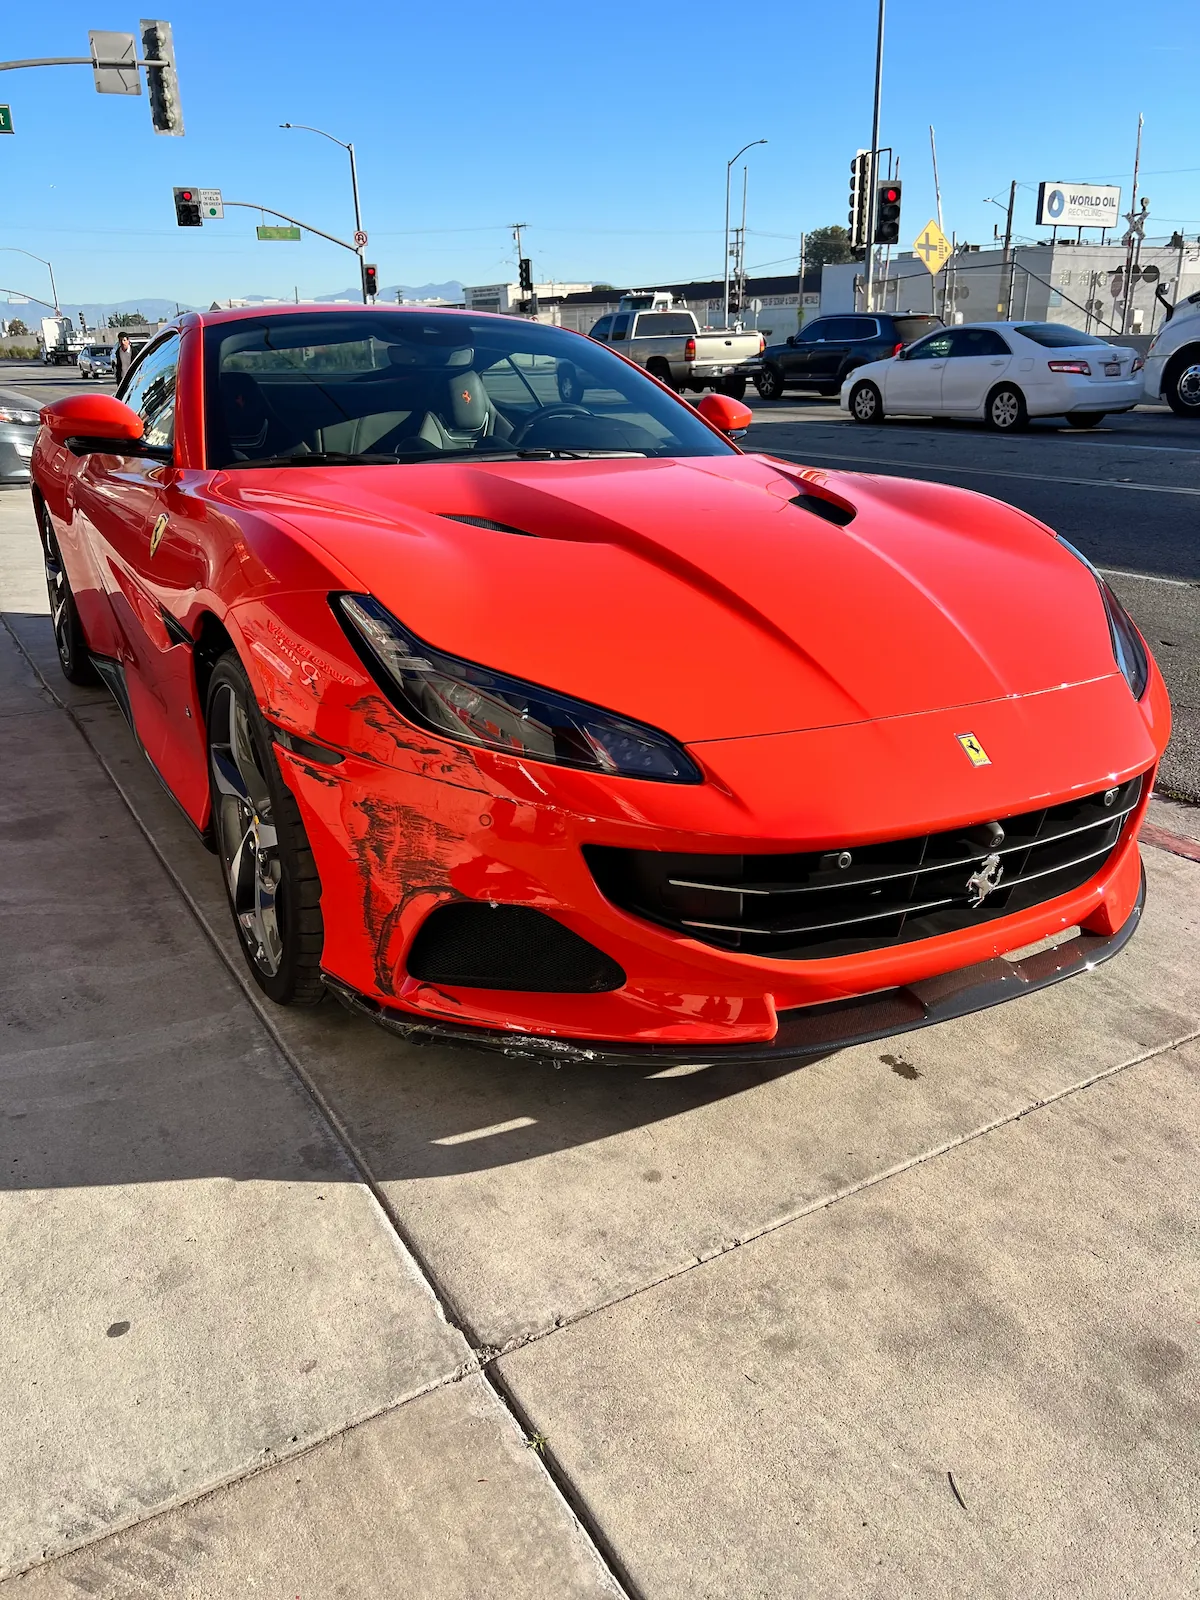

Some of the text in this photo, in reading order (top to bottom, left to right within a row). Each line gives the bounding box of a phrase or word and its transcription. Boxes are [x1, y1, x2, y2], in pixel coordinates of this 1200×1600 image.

[1069, 195, 1116, 208] WORLD OIL
[1067, 208, 1102, 217] RECYCLING
